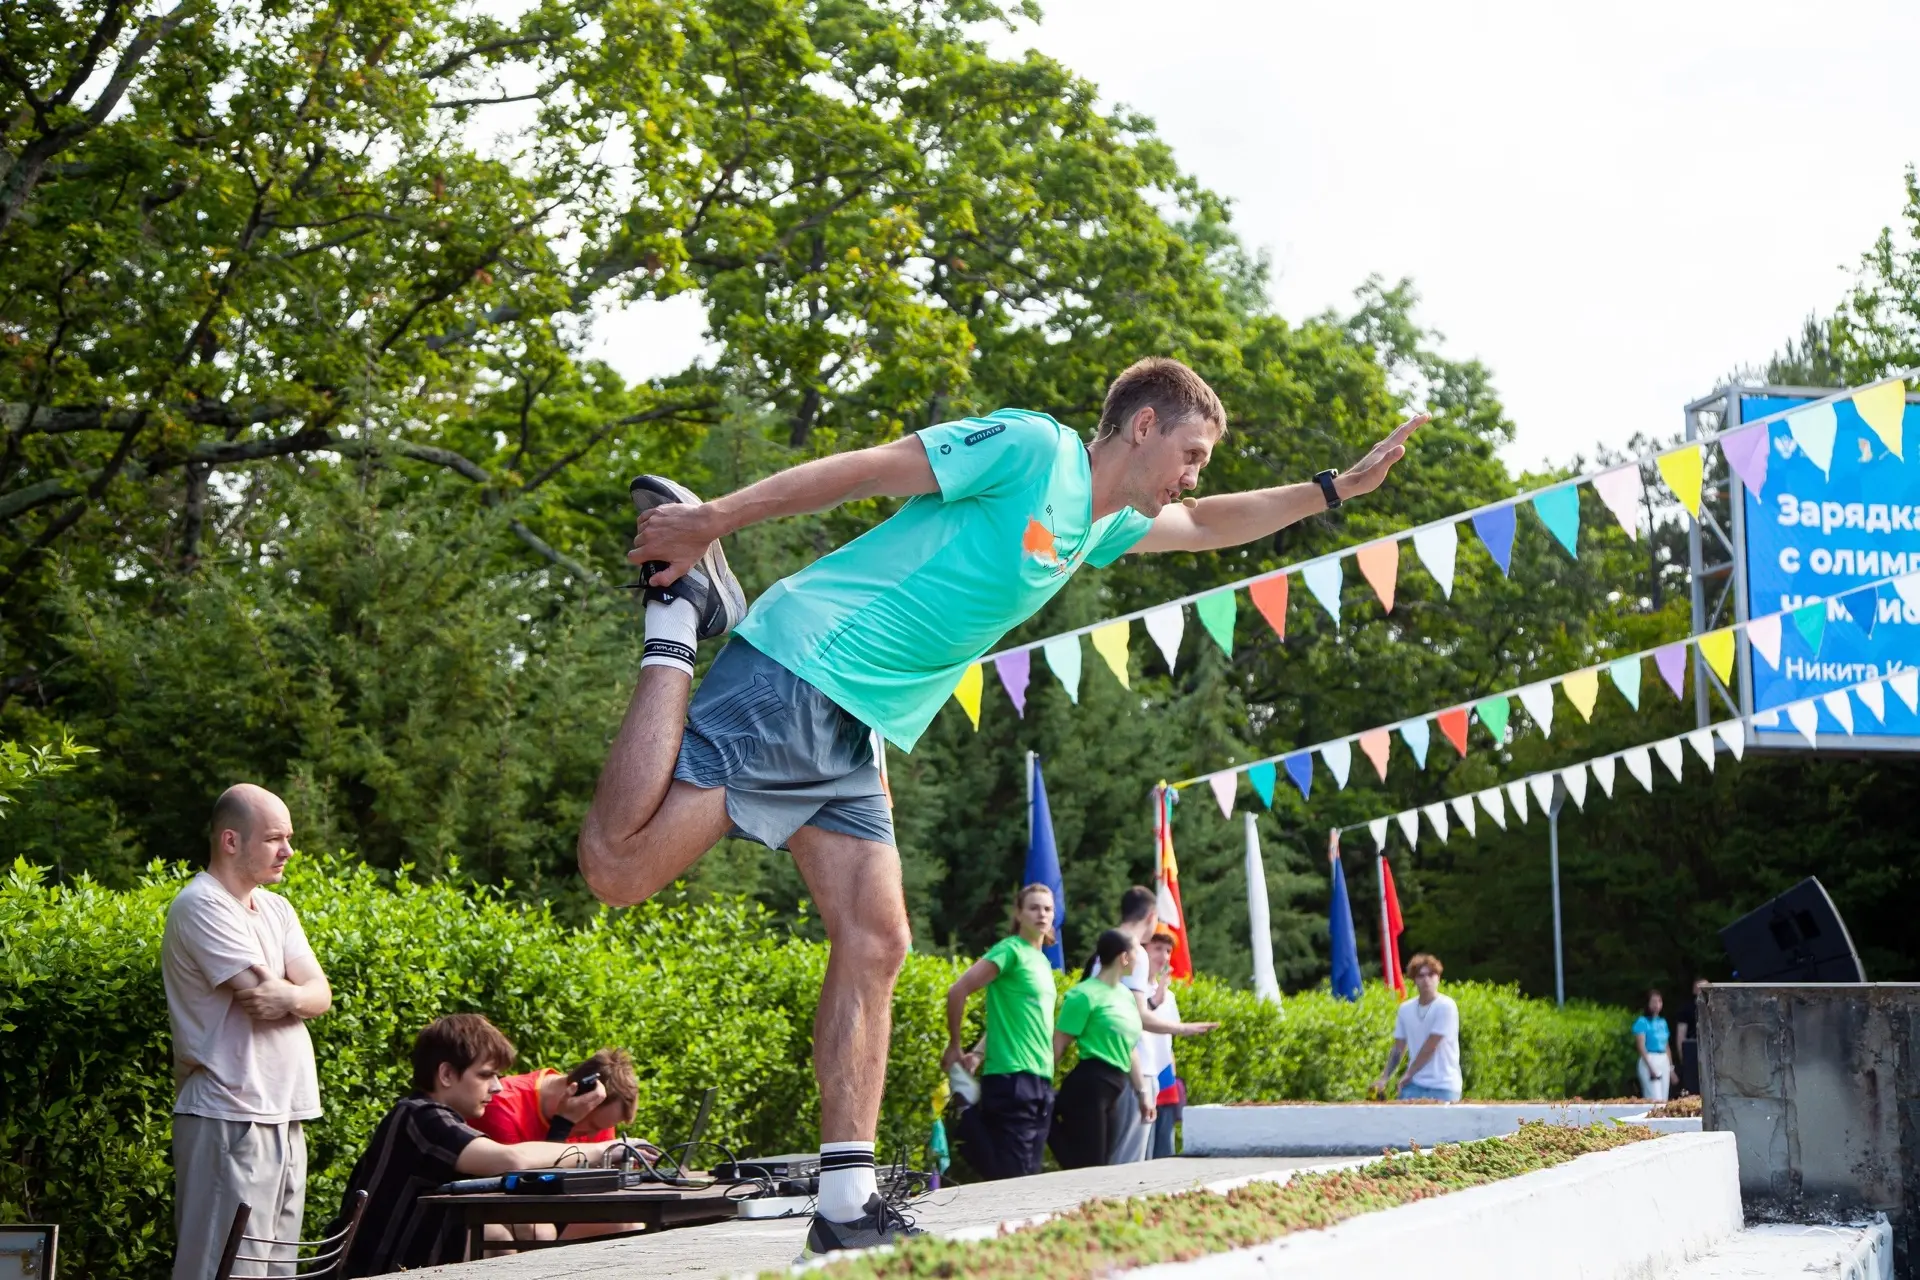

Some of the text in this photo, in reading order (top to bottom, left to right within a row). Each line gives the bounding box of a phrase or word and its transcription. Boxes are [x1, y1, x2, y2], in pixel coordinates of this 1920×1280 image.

[969, 426, 1001, 443] BIVIUM
[1779, 547, 1800, 574] с
[1785, 656, 1879, 681] Никита
